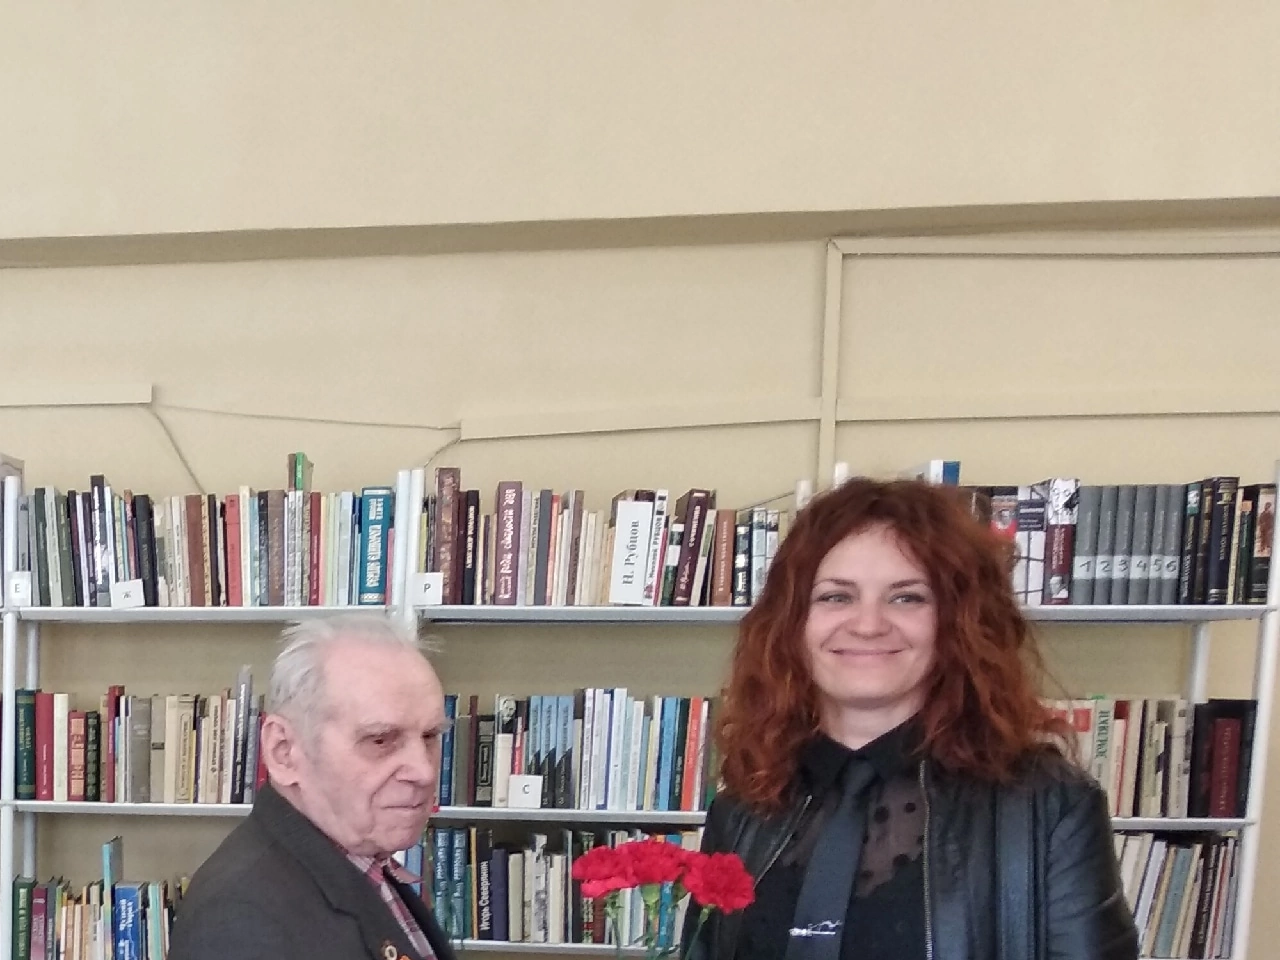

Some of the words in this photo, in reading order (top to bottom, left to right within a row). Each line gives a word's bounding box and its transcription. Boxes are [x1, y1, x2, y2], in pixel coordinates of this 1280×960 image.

[623, 520, 640, 566] Рубцов
[1080, 561, 1091, 572] 1
[1100, 561, 1111, 572] 2
[1118, 559, 1128, 571] 3
[1136, 560, 1147, 572] 4
[1153, 559, 1162, 571] 5
[623, 571, 635, 585] Н.
[479, 860, 491, 906] Северянин
[479, 906, 491, 931] Игорь
